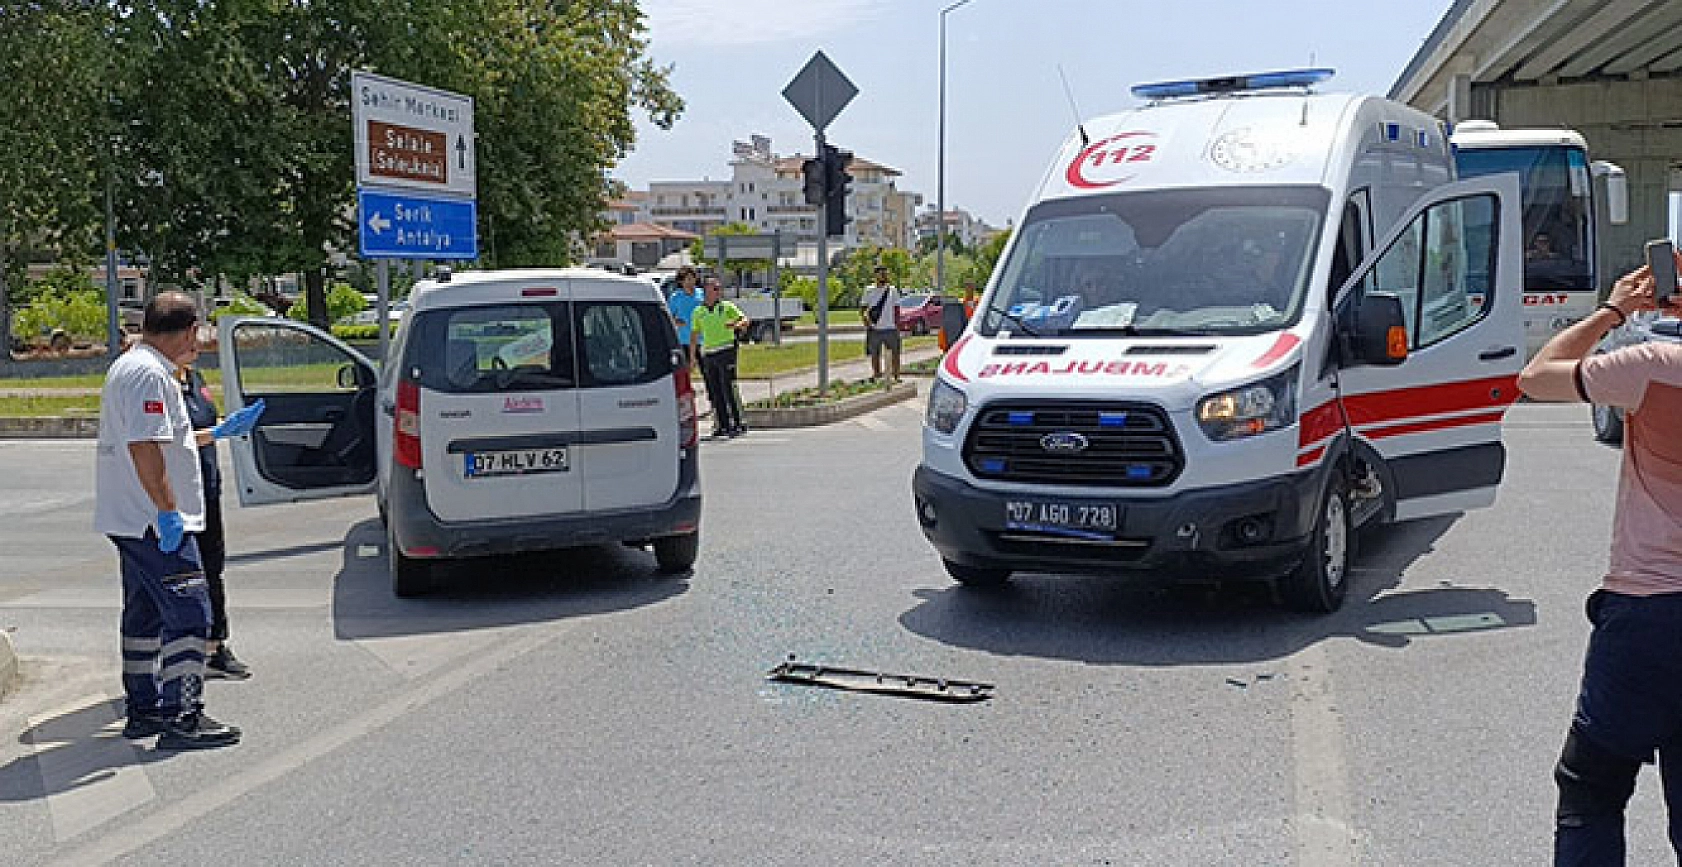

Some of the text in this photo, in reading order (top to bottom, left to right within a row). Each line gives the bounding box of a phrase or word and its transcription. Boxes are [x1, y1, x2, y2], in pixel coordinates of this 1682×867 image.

[1090, 144, 1156, 168] 112
[394, 203, 432, 223] Serik
[397, 227, 452, 250] Antalya
[473, 450, 566, 472] 07 HLV 62
[1013, 502, 1034, 521] 07
[1078, 506, 1112, 528] 728
